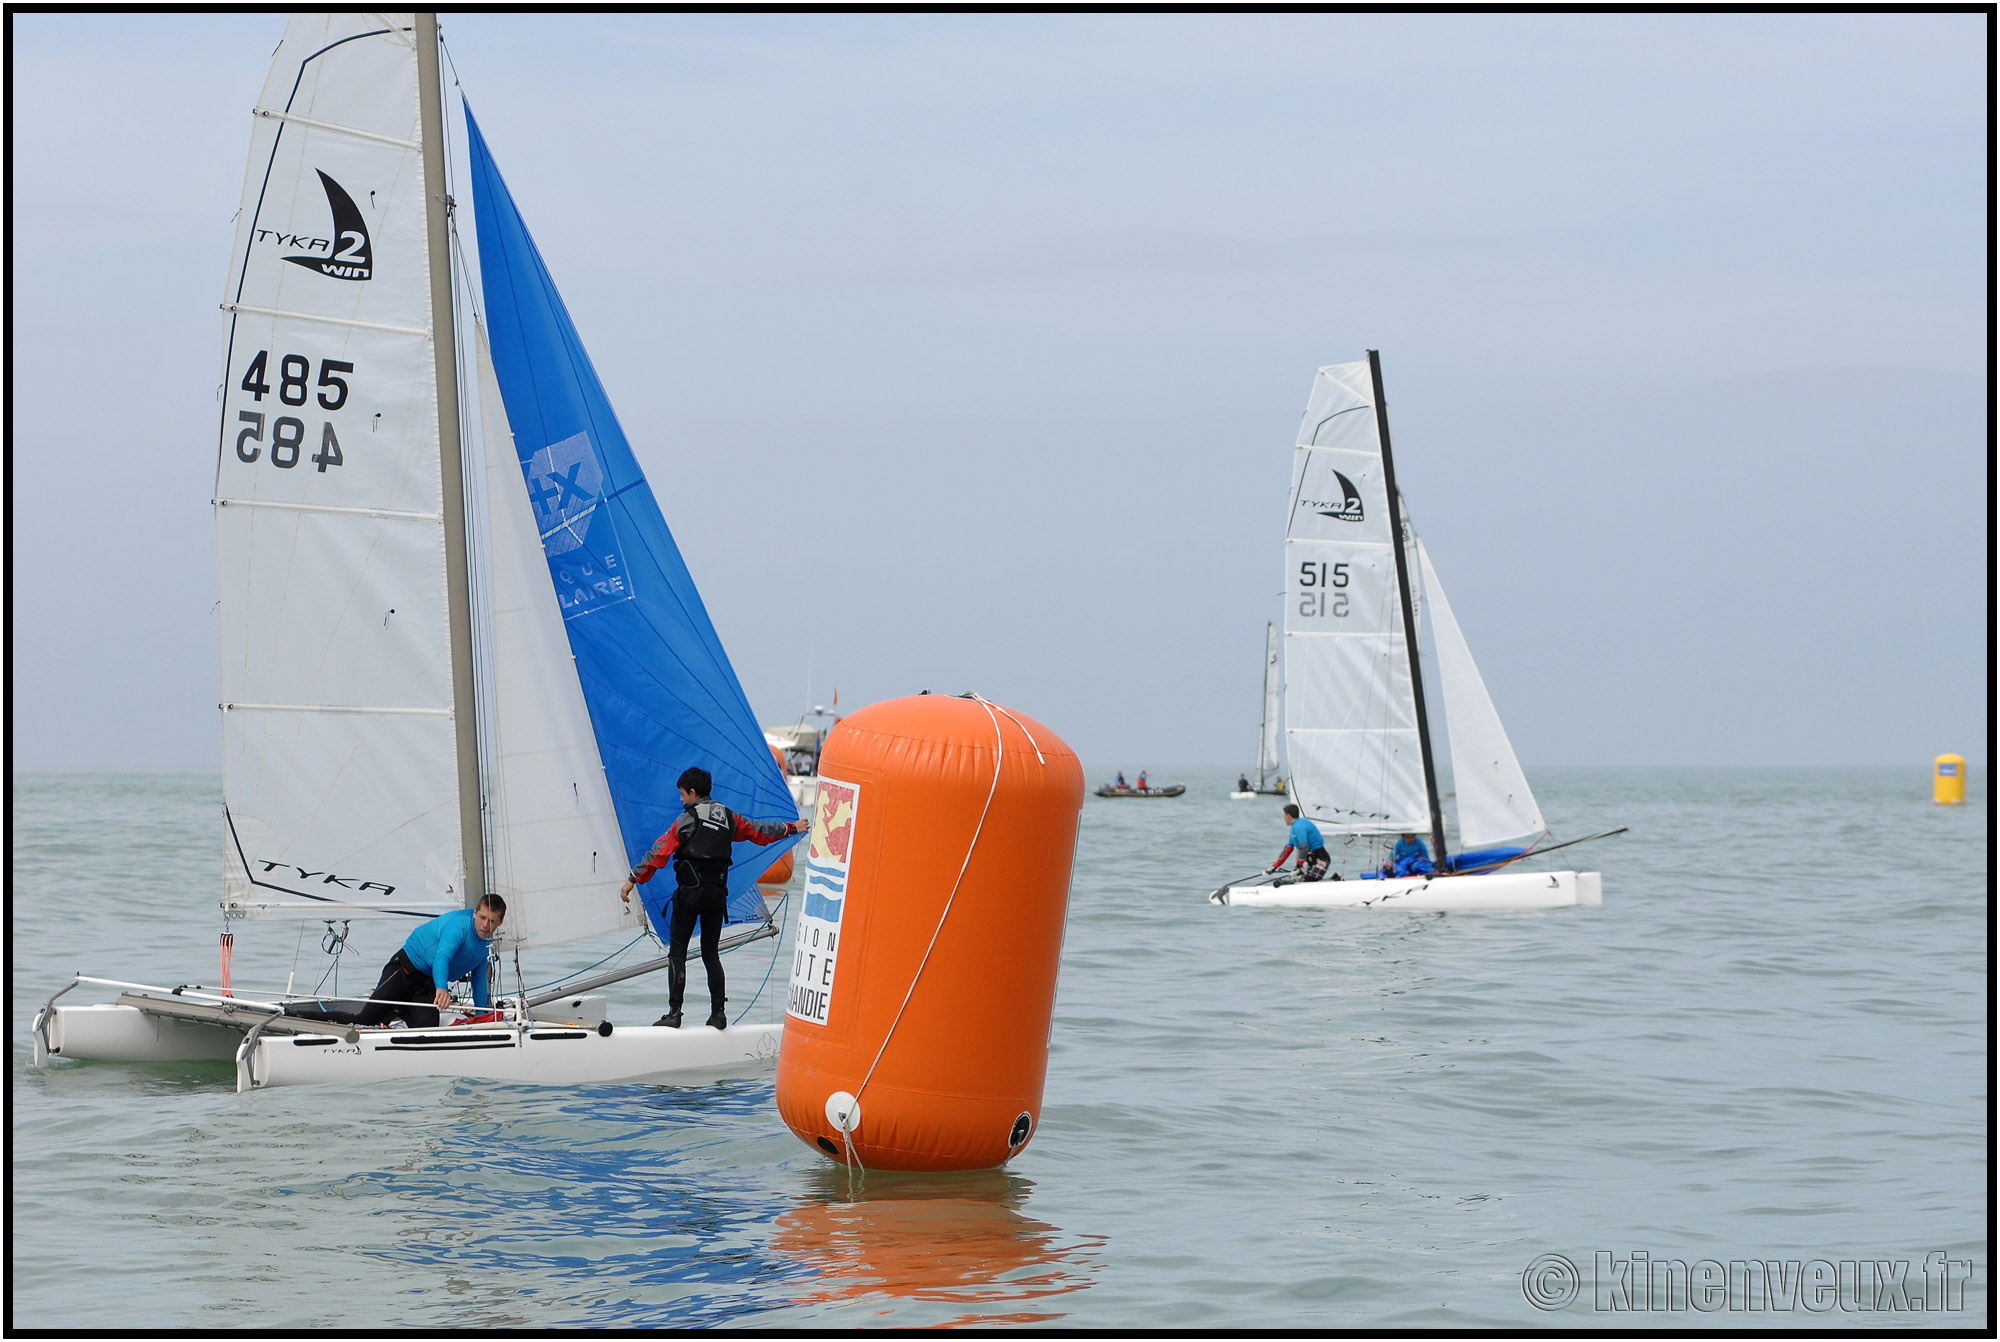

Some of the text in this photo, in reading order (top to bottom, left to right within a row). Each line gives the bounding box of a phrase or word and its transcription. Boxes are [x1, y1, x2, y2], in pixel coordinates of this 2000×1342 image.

[256, 229, 366, 264] TYKA 2
[241, 350, 354, 411] 485
[1300, 497, 1361, 513] TYKA 2
[1300, 561, 1349, 588] 515
[258, 859, 395, 895] TYKA
